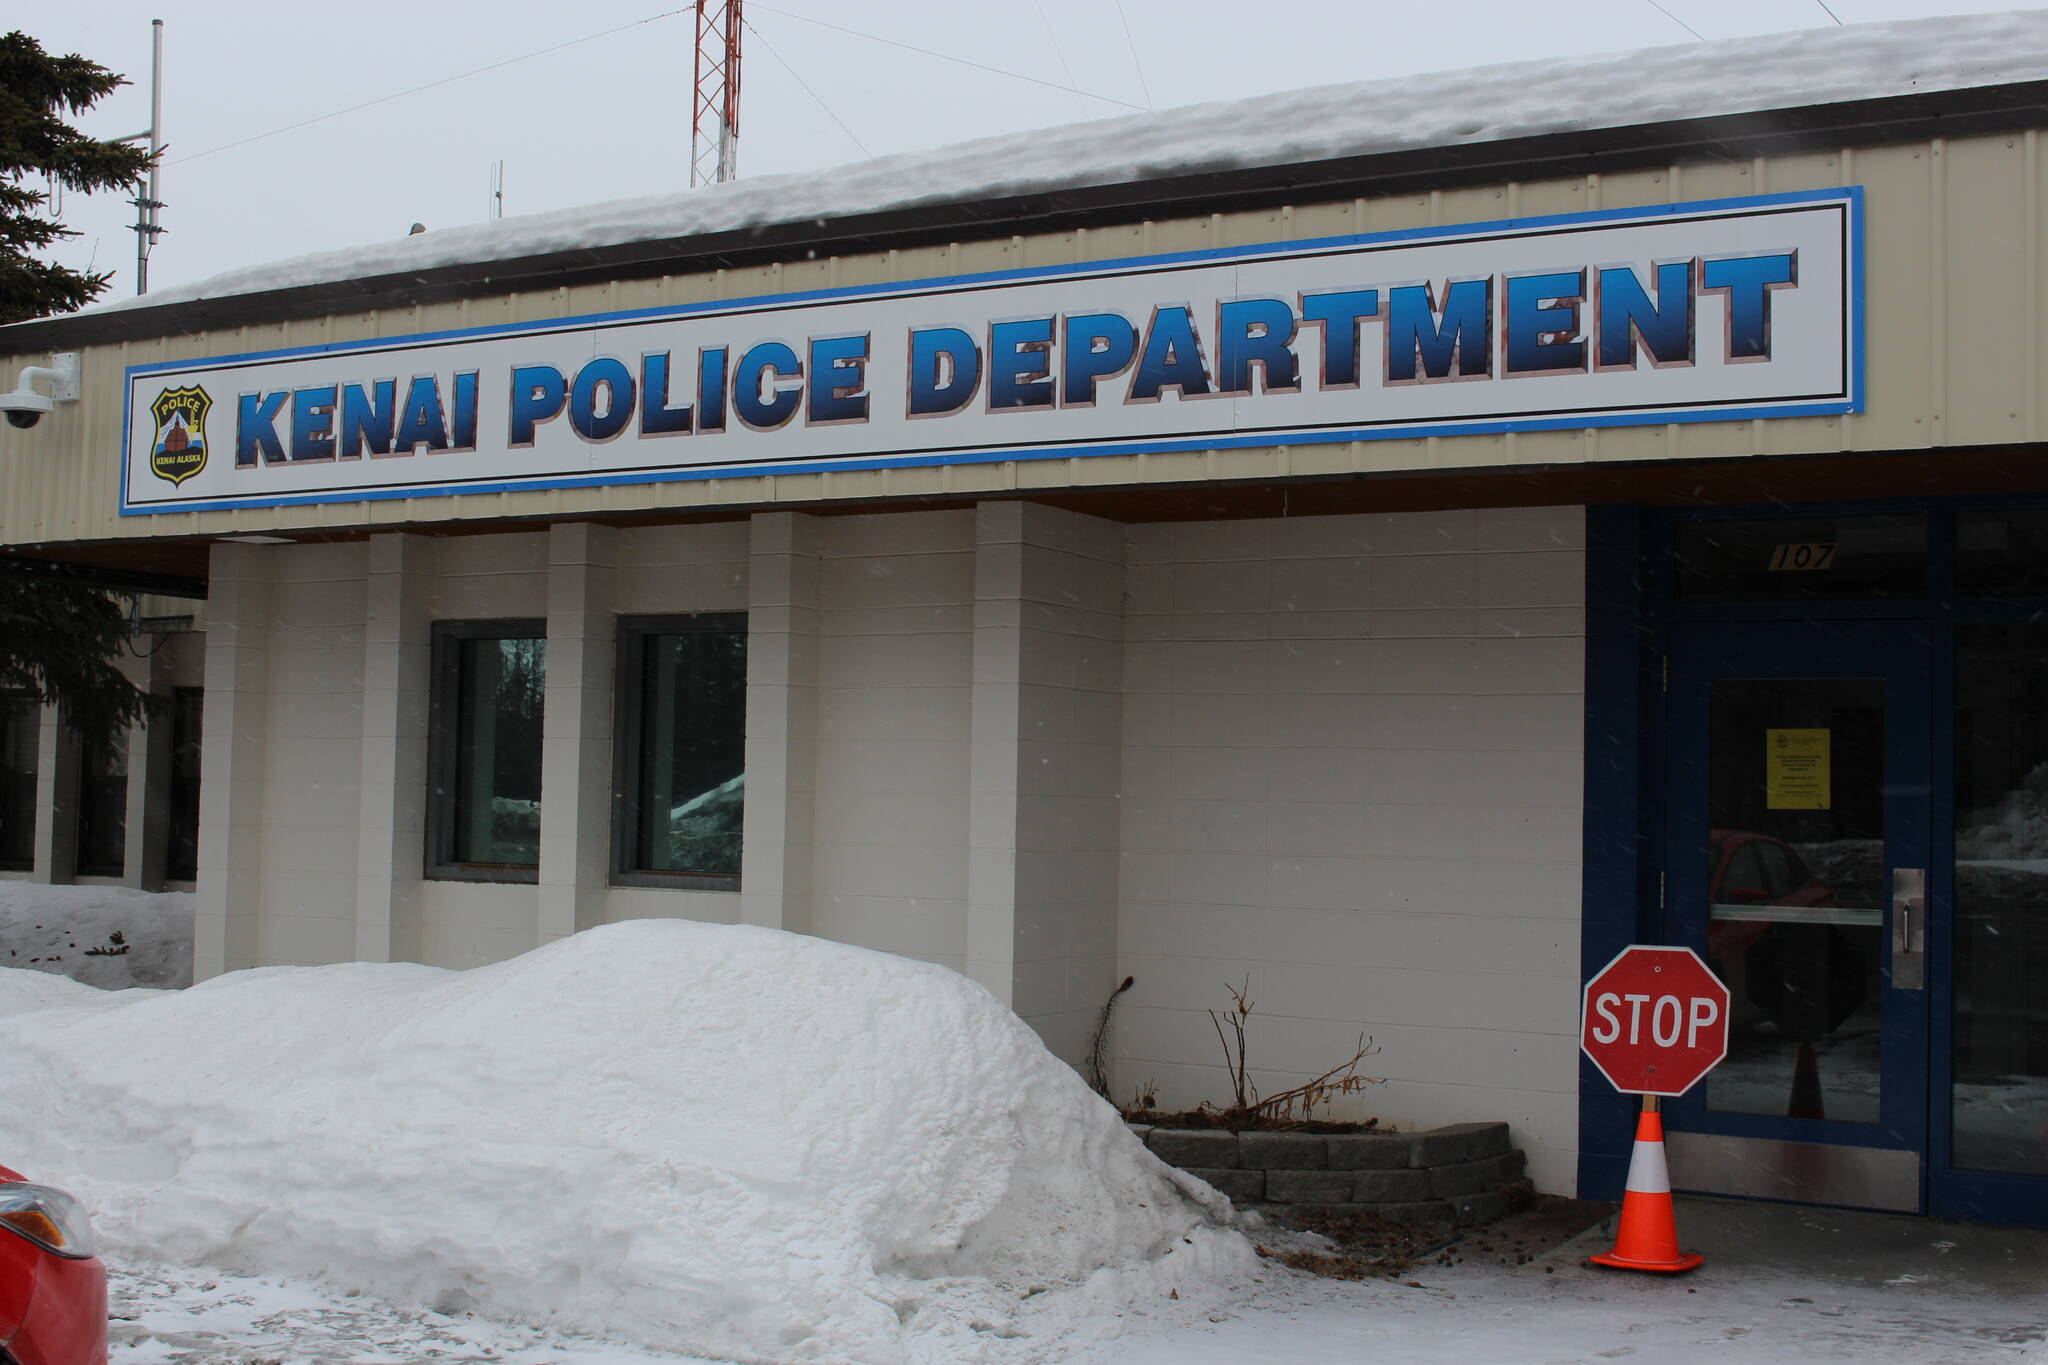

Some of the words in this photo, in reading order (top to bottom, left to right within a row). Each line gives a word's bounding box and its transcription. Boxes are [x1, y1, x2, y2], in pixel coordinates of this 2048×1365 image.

[235, 368, 480, 470] KENAI
[507, 330, 871, 449] POLICE
[905, 247, 1799, 420] DEPARTMENT
[161, 397, 200, 415] POLICE
[156, 457, 175, 465] KENAI
[176, 455, 201, 463] ALASKA
[1778, 545, 1835, 568] 107
[1592, 992, 1718, 1048] STOP
